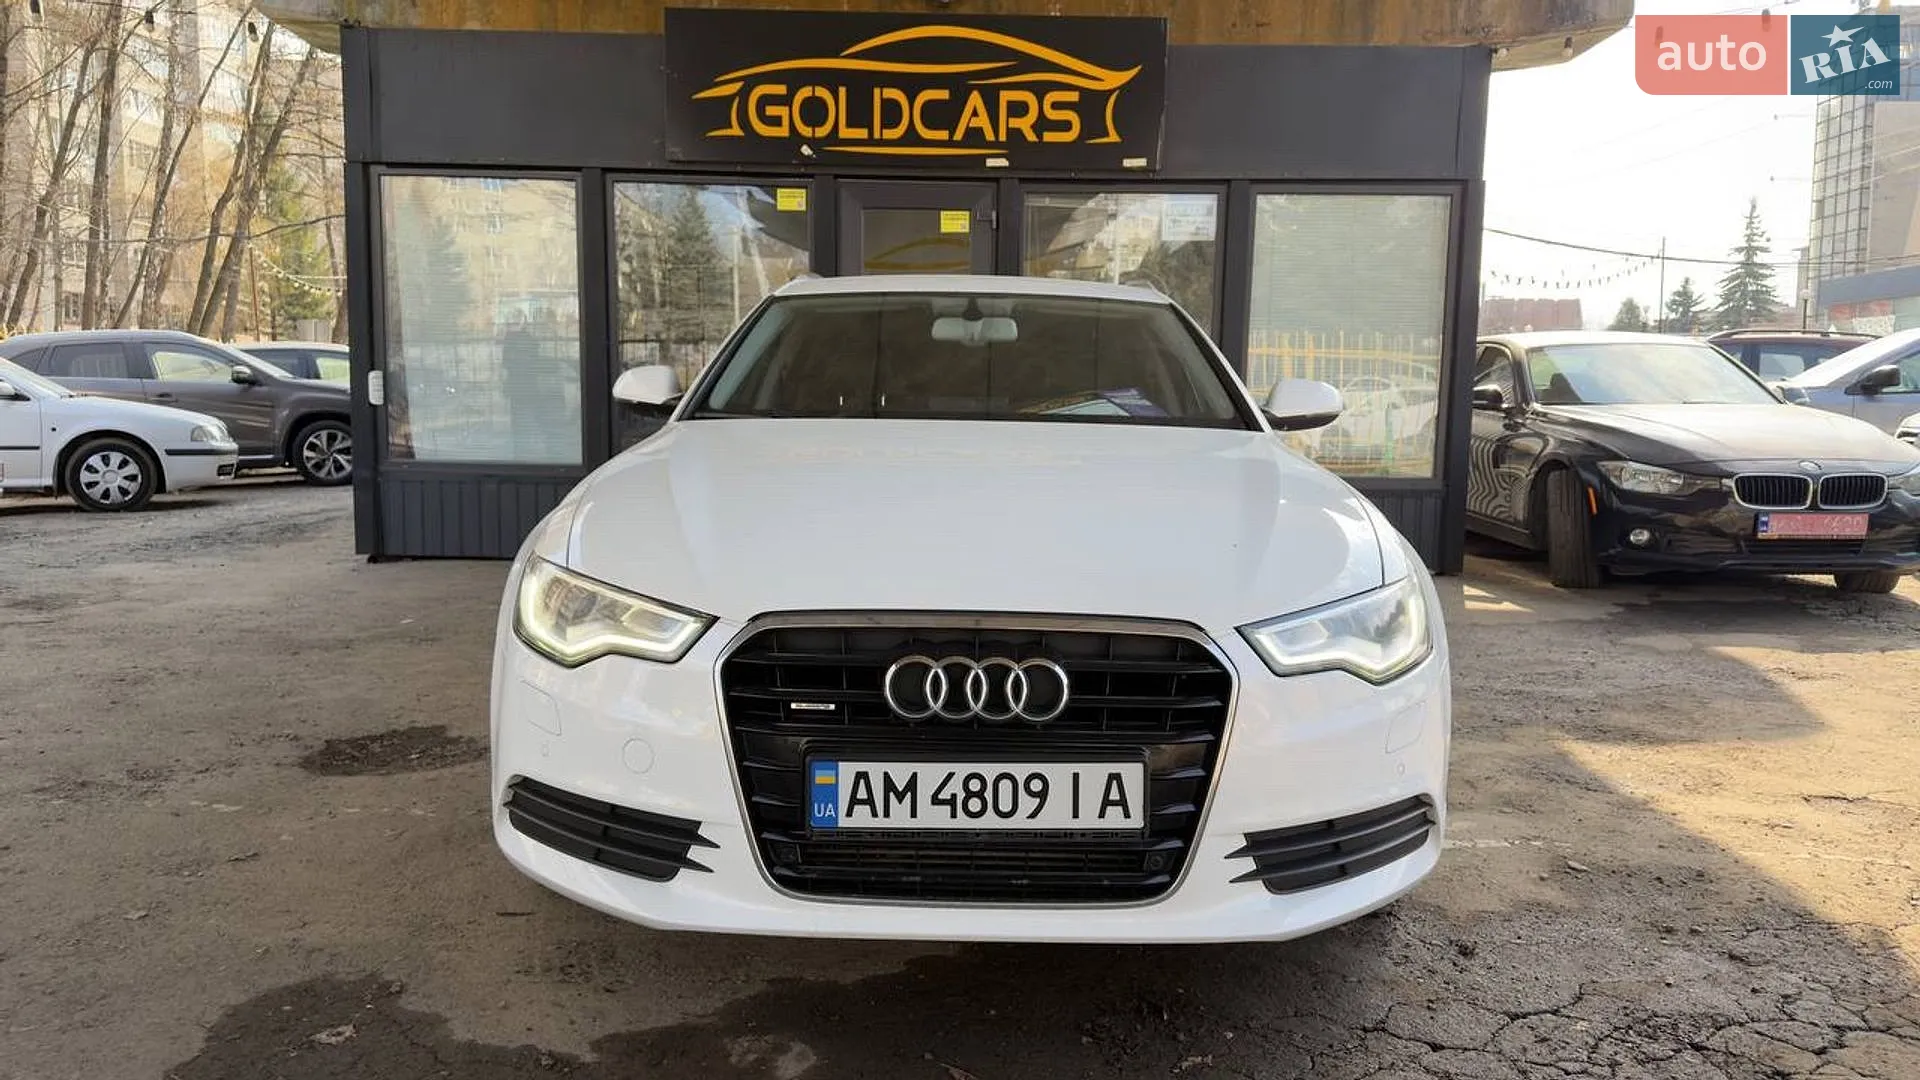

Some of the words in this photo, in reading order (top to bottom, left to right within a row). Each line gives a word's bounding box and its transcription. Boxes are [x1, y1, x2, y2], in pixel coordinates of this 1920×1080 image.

[747, 83, 1081, 143] GOLDCARS
[814, 802, 837, 818] UA
[845, 770, 918, 819] AM
[930, 771, 1050, 819] 4809
